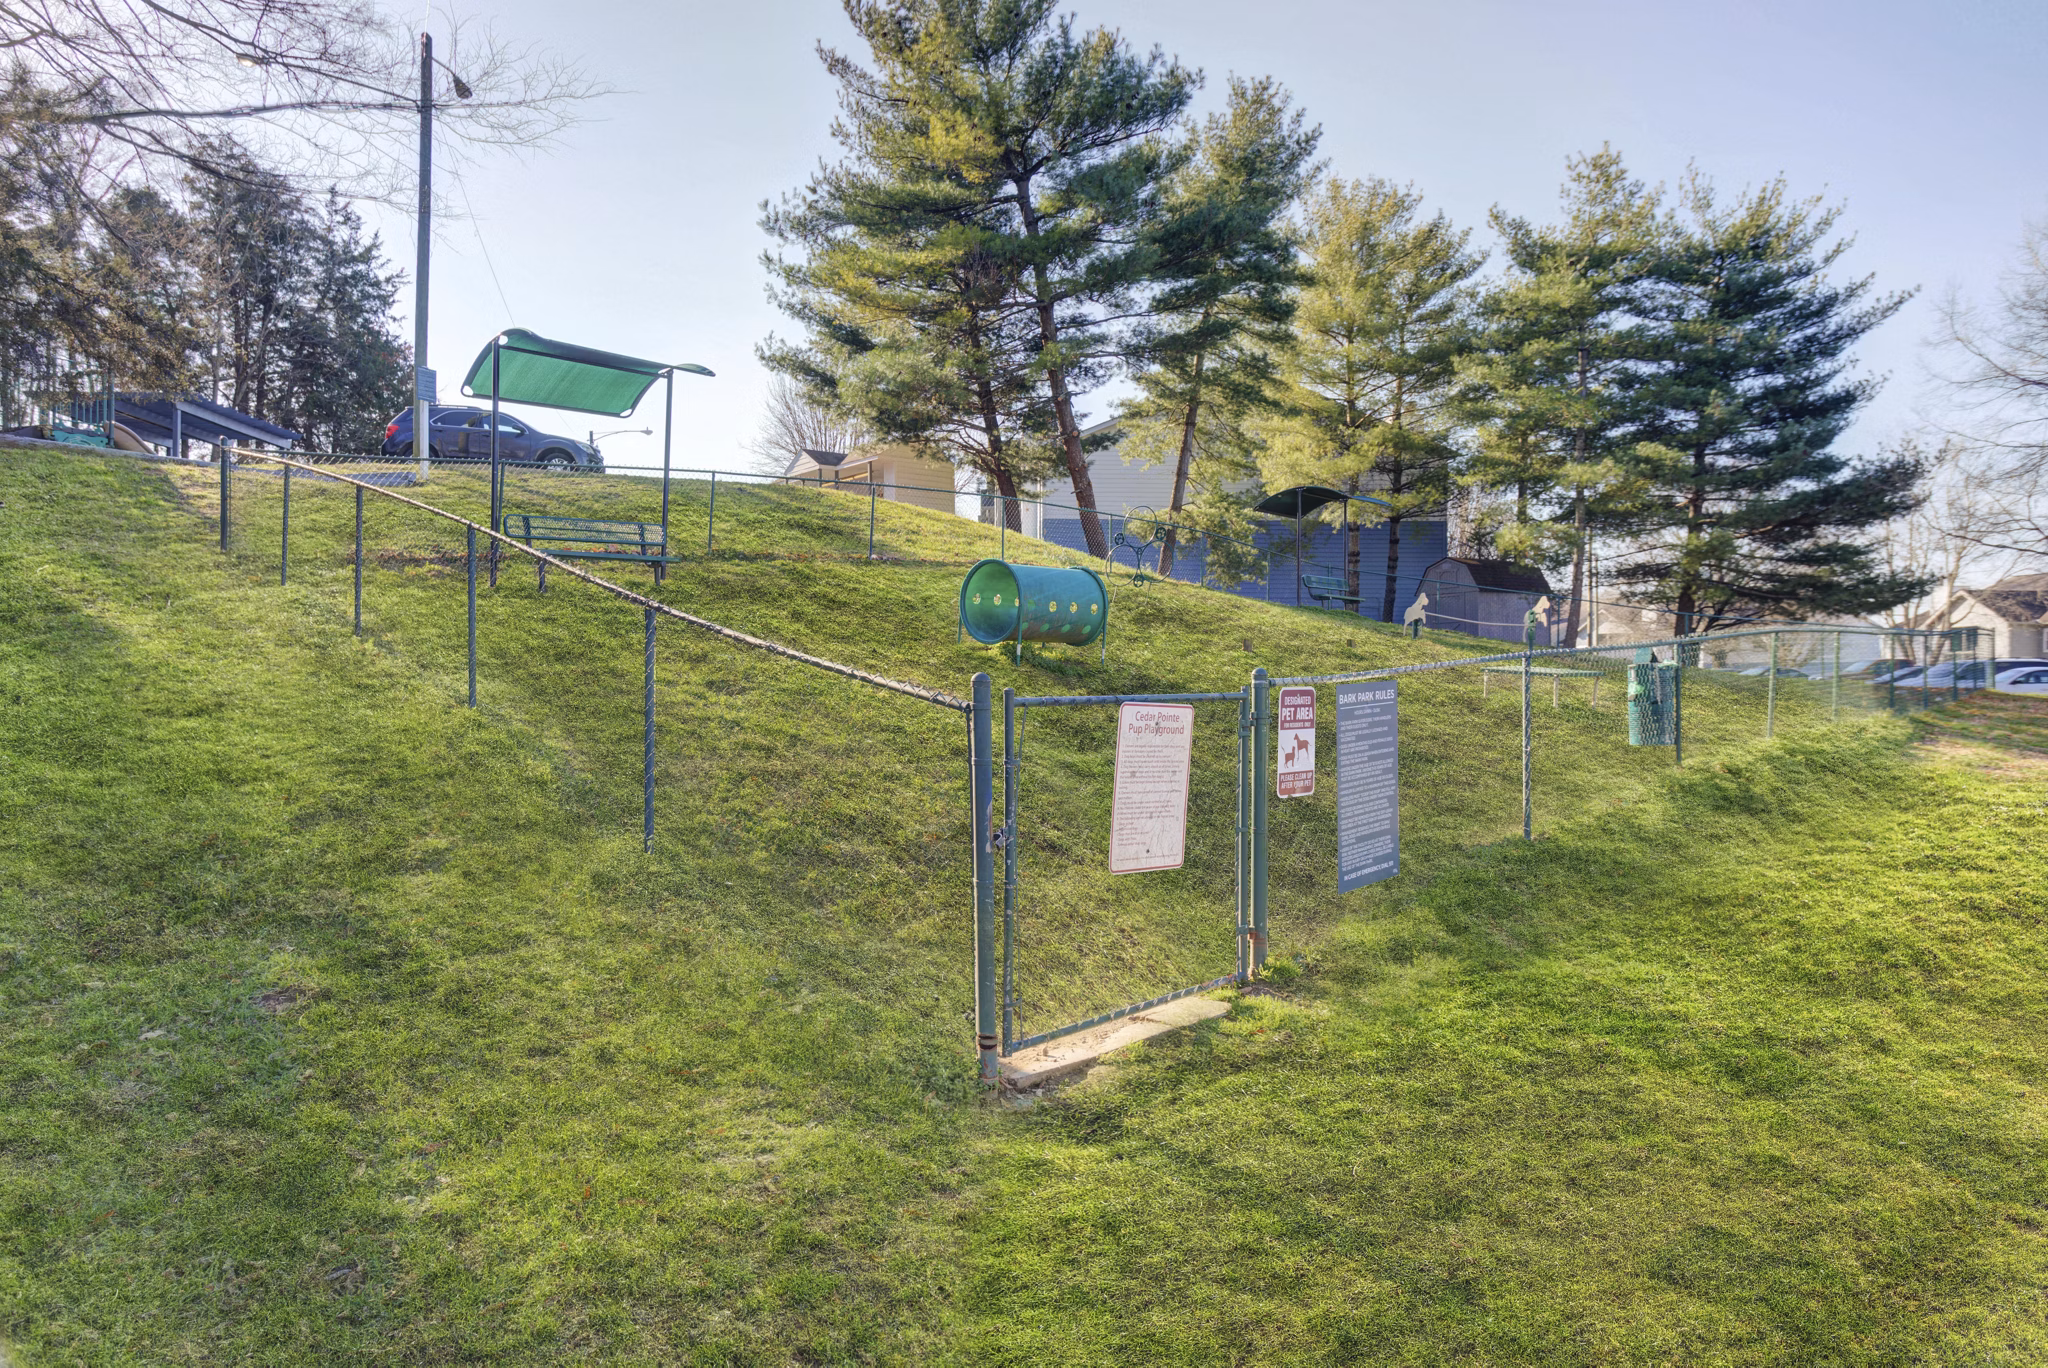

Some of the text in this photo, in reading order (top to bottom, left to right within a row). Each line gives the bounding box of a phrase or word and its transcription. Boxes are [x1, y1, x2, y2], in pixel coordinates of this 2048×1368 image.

[1284, 696, 1312, 705] DESIGNATED
[1339, 690, 1394, 704] BARK PARK RULES
[1136, 711, 1180, 722] Cedar Pointe
[1282, 706, 1313, 720] PET AREA
[1128, 724, 1184, 736] Pup Playground
[1280, 774, 1294, 782] PLEASE
[1294, 780, 1304, 788] YOUR
